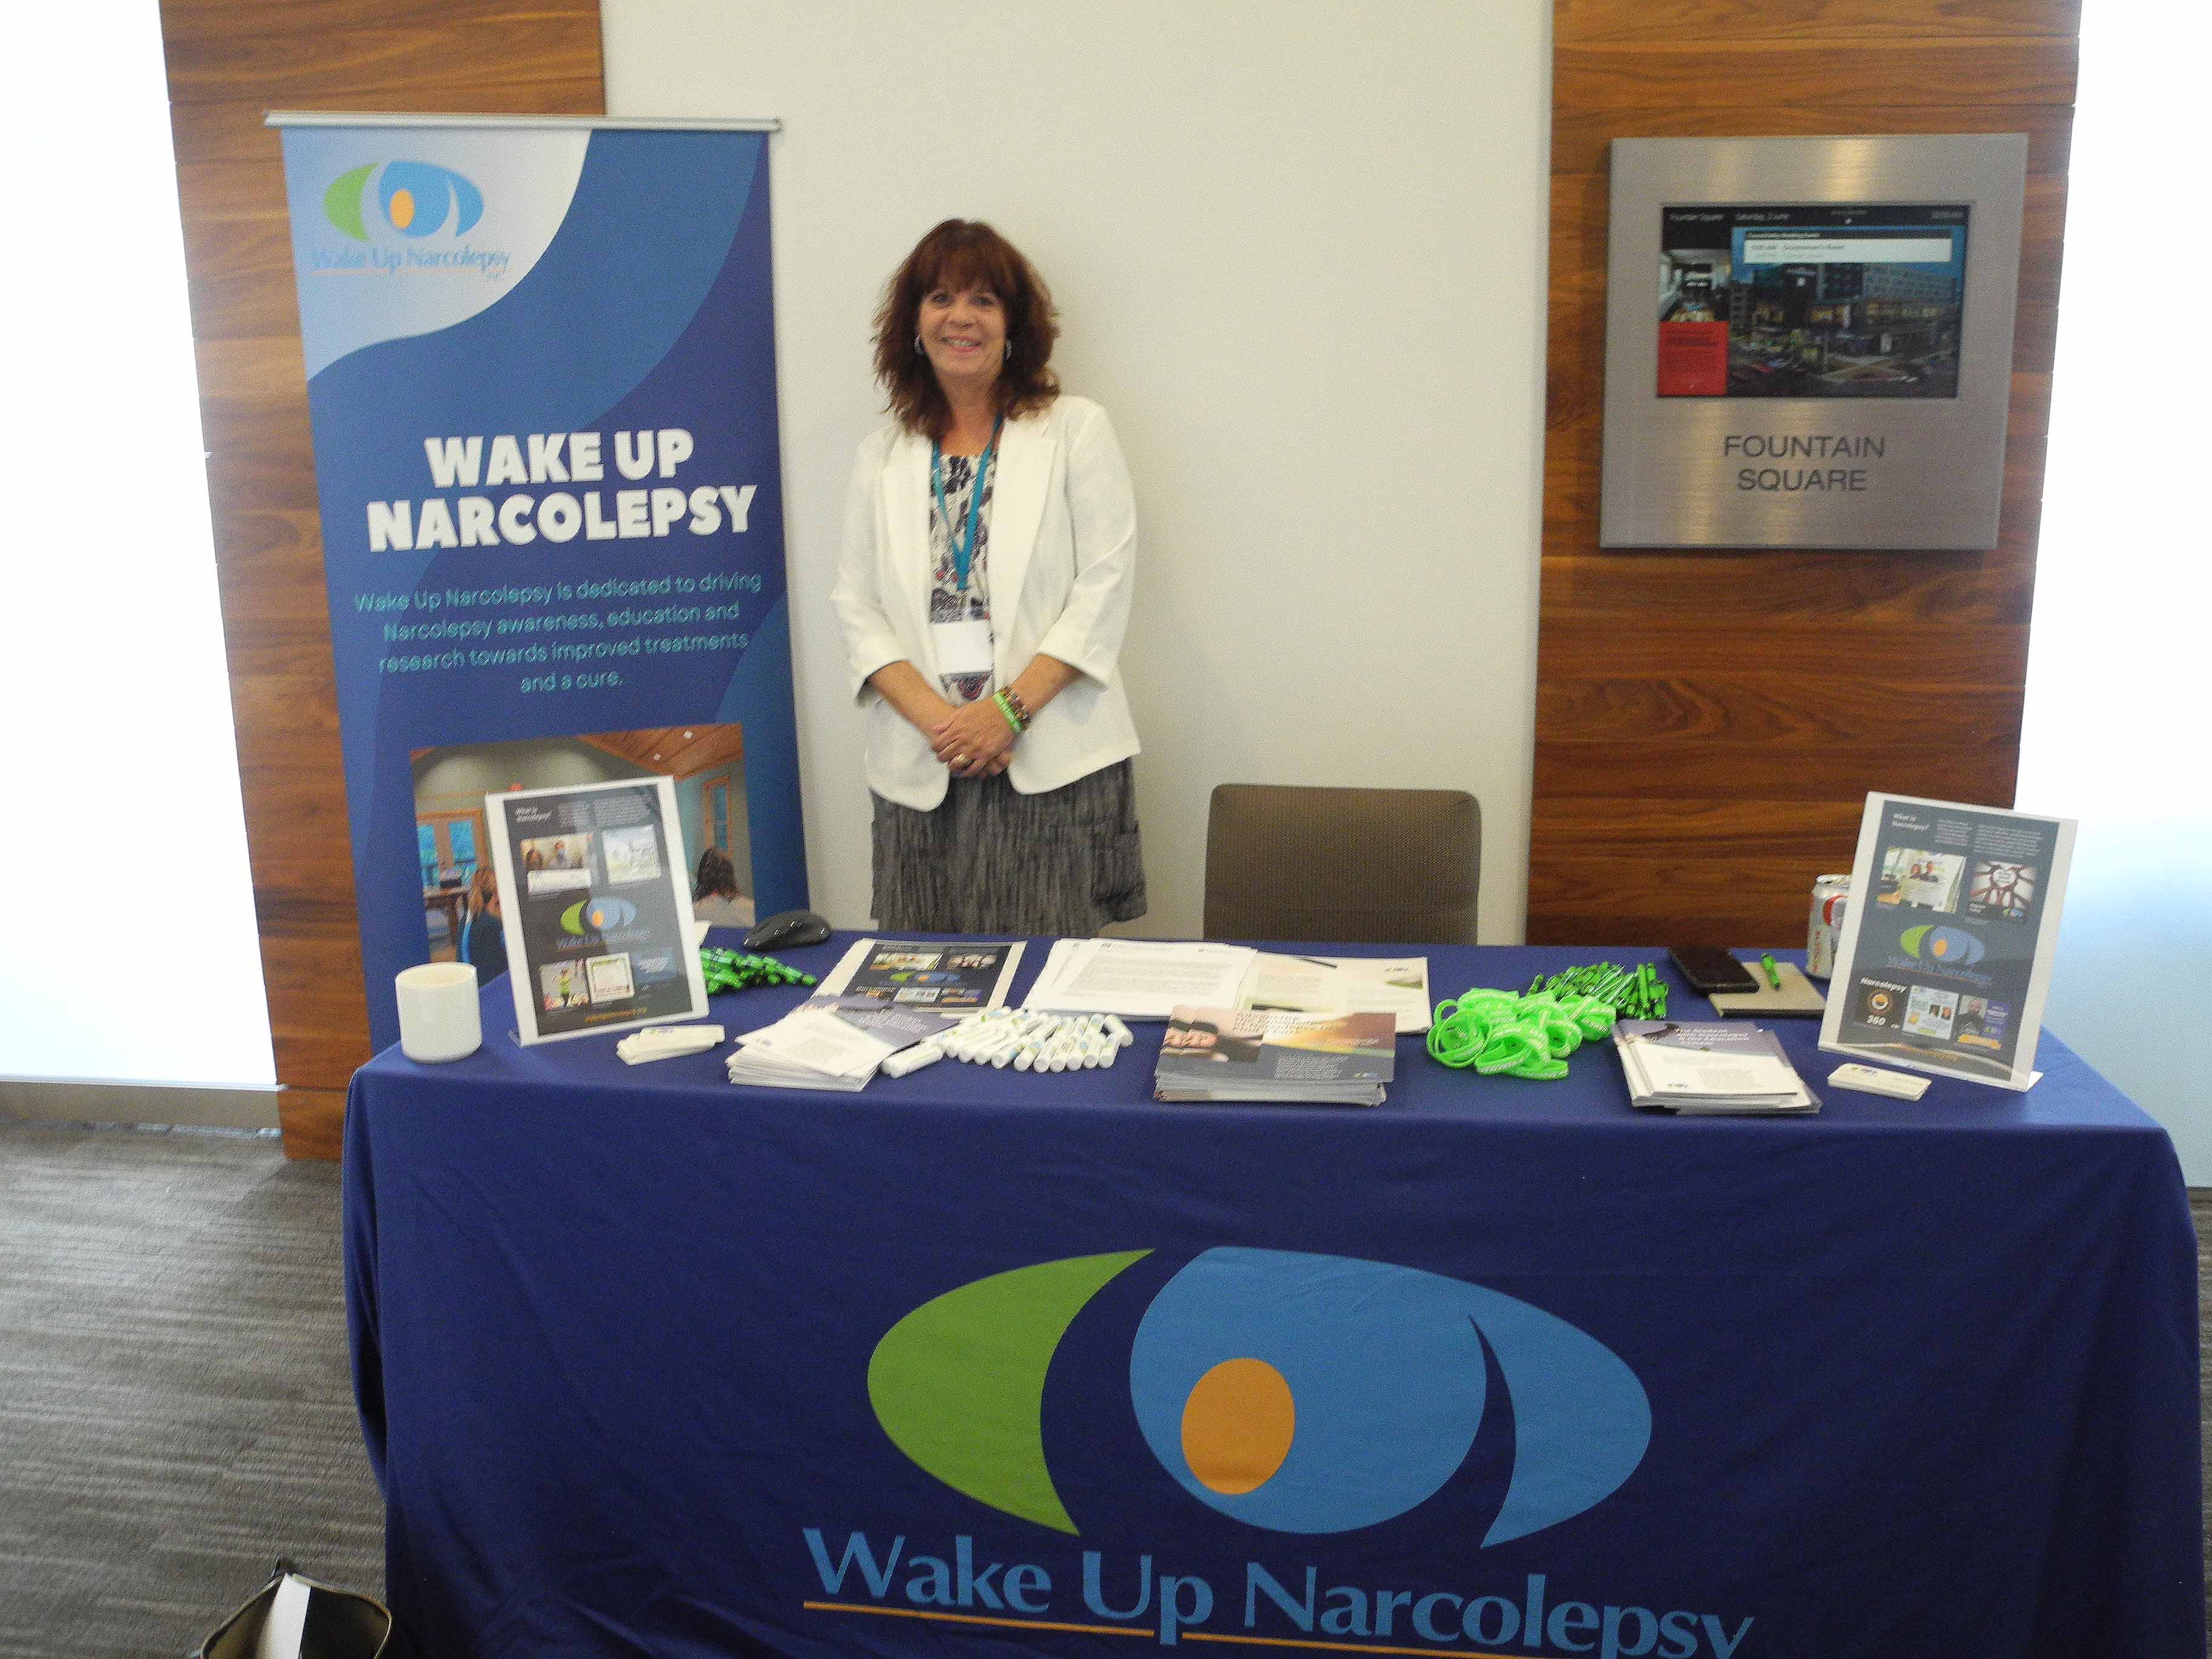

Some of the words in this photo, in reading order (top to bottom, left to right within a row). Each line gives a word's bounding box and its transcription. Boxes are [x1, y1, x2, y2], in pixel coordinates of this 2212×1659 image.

[372, 246, 403, 275] Up
[408, 243, 511, 272] Narcolepsy
[424, 431, 605, 488] WAKE
[614, 427, 694, 480] UP
[1724, 435, 1885, 458] FOUNTAIN
[1737, 469, 1867, 491] SQUARE
[366, 484, 757, 552] NARCOLEPSY
[354, 591, 409, 613] Wake
[415, 589, 441, 612] Up
[446, 583, 552, 609] Narcolepsy
[557, 581, 572, 602] is
[577, 577, 671, 600] dedicated
[675, 575, 695, 595] to
[699, 572, 762, 597] driving
[384, 619, 492, 643] Narcolepsy
[497, 611, 603, 637] awareness,
[608, 605, 701, 628] education
[705, 601, 739, 622] and
[378, 645, 465, 673] research
[469, 642, 548, 666] towards
[552, 636, 640, 662] improved
[643, 631, 749, 657] treatments
[520, 671, 555, 693] and
[561, 674, 573, 690] a
[577, 669, 623, 689] cure.
[802, 1527, 1053, 1613] Wake
[1081, 1549, 1212, 1646] Up
[1244, 1561, 1754, 1659] Narcolepsy
